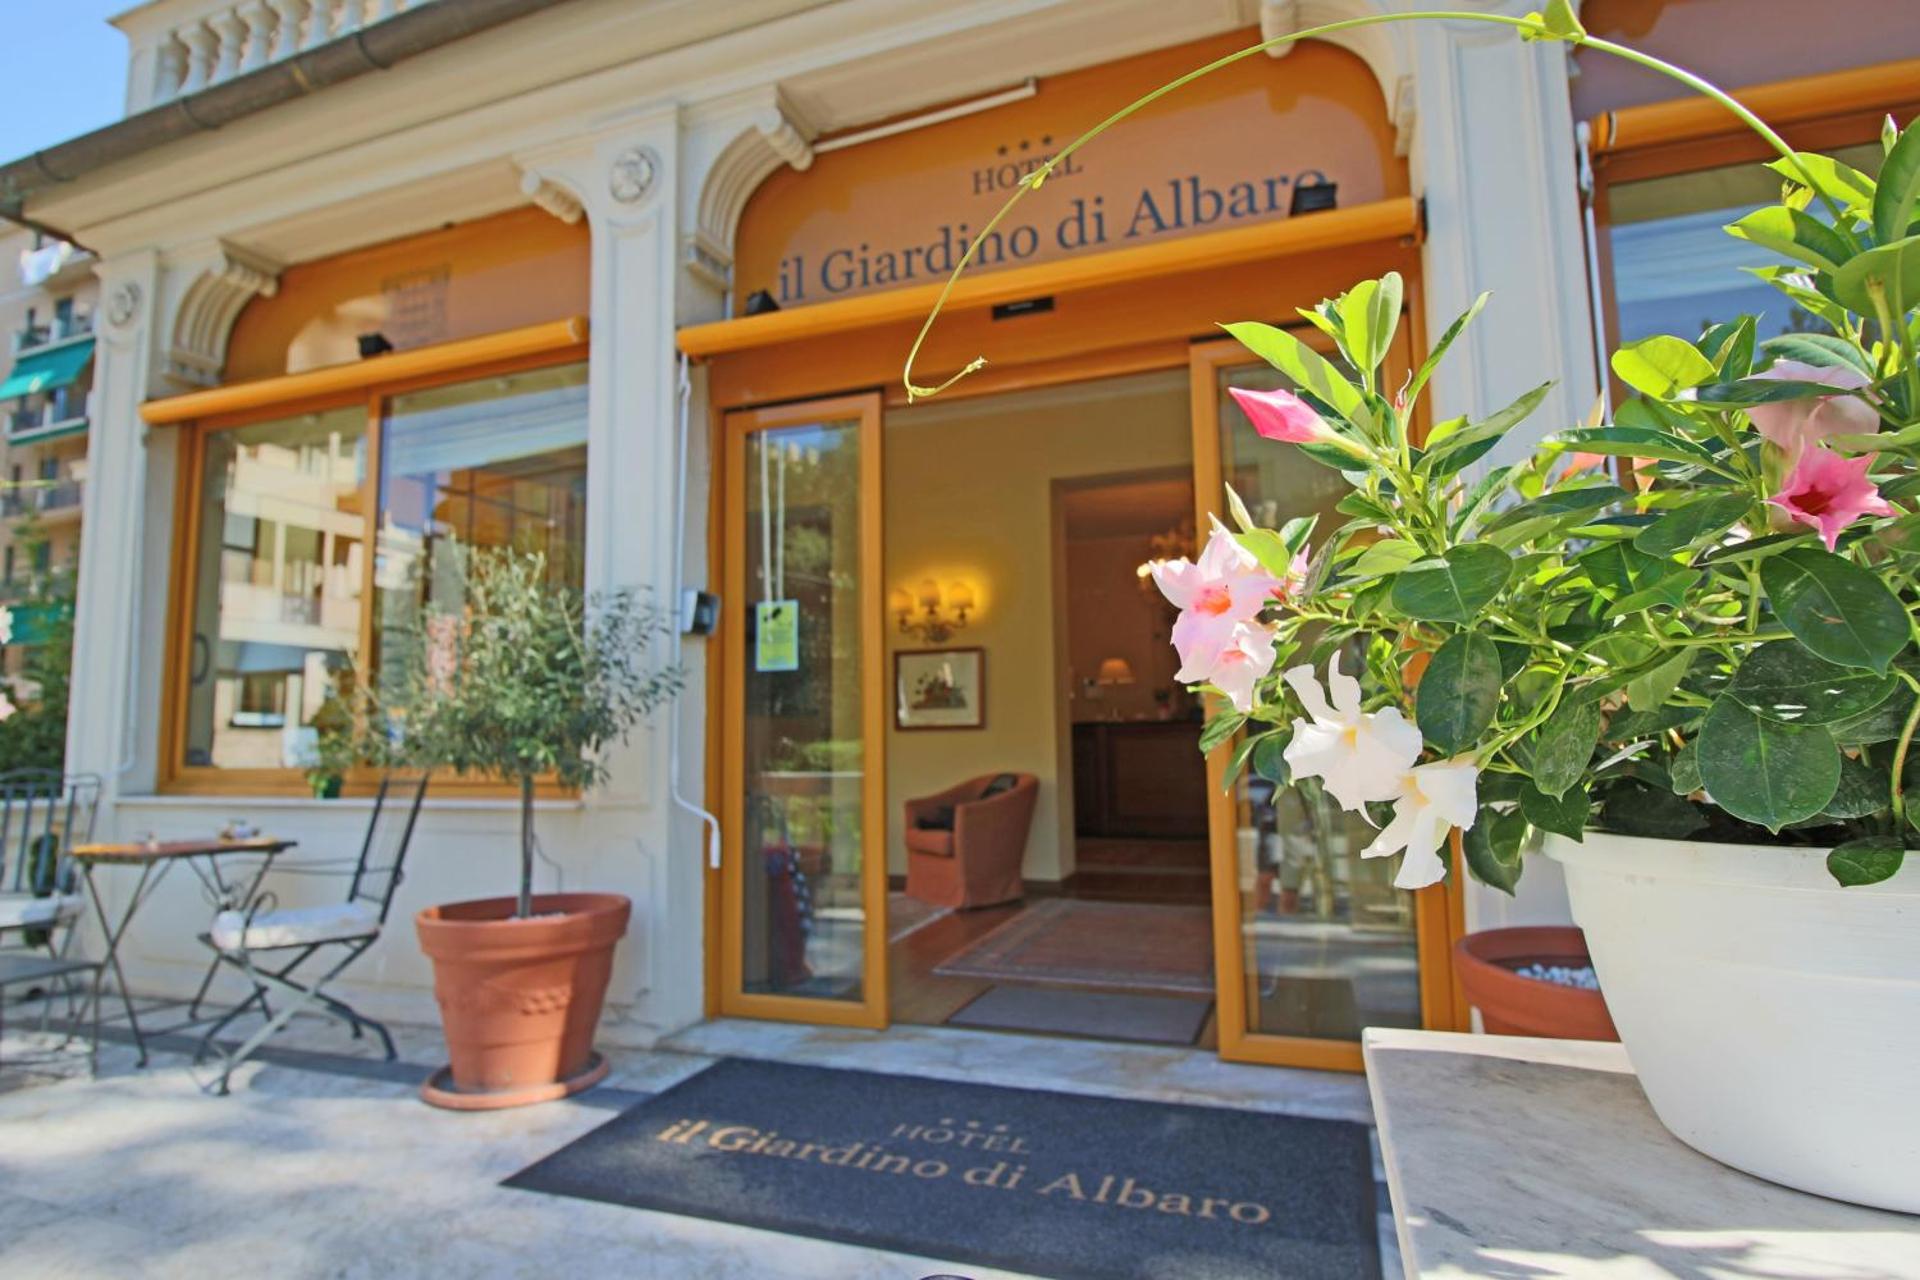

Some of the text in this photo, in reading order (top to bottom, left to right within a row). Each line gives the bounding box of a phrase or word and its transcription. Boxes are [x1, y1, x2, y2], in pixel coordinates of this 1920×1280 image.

[779, 256, 805, 301] il
[820, 223, 1039, 293] Giardino
[1056, 196, 1107, 249] di
[656, 1119, 1270, 1225] il Giardino di Albaro
[892, 1122, 1031, 1155] HOTEL
